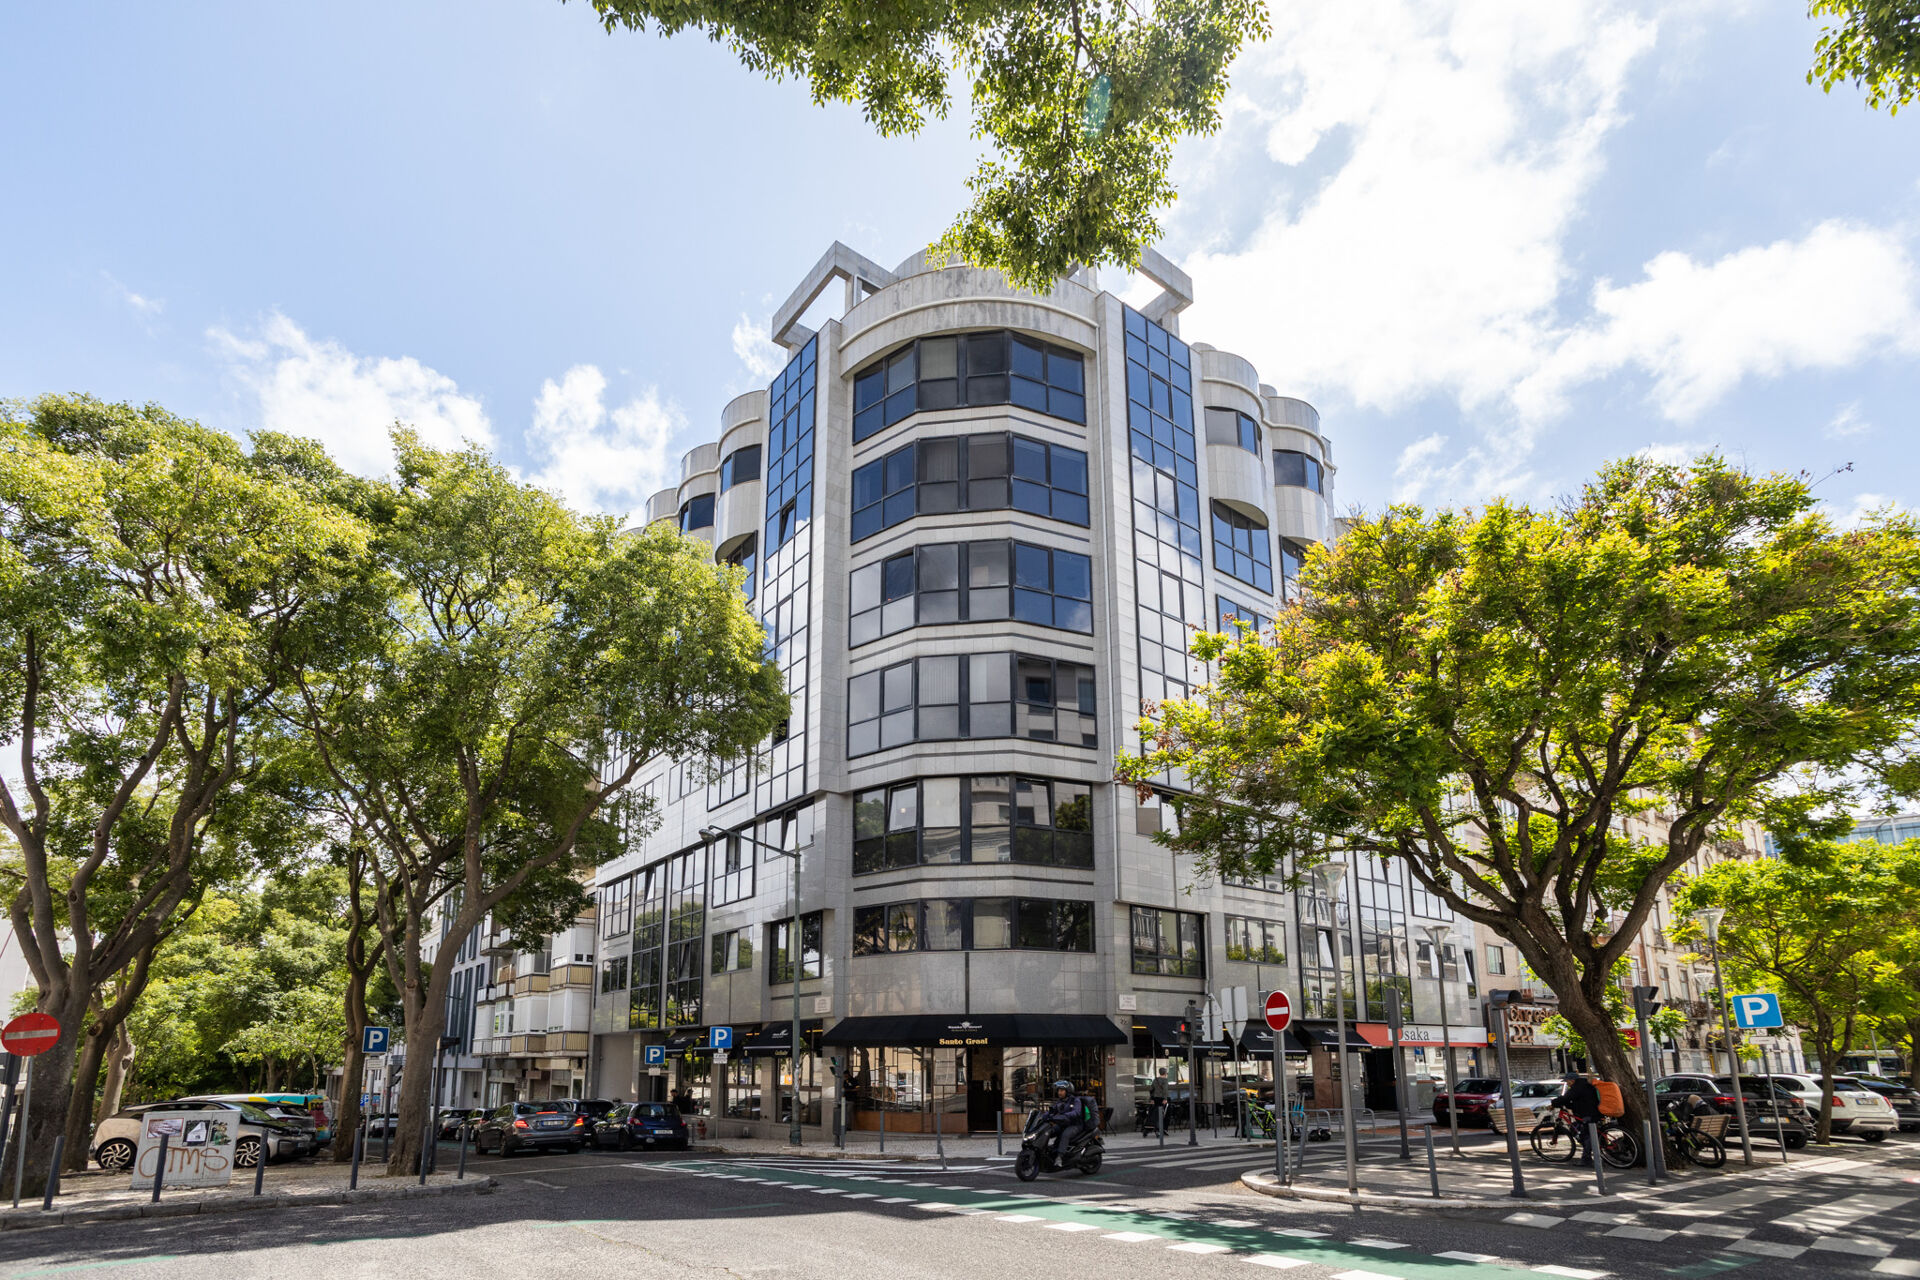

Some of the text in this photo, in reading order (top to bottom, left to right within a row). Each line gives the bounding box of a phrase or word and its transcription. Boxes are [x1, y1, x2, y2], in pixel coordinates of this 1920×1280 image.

[1741, 997, 1769, 1025] P
[368, 1030, 384, 1049] P
[714, 1029, 728, 1046] P
[649, 1048, 661, 1062] P
